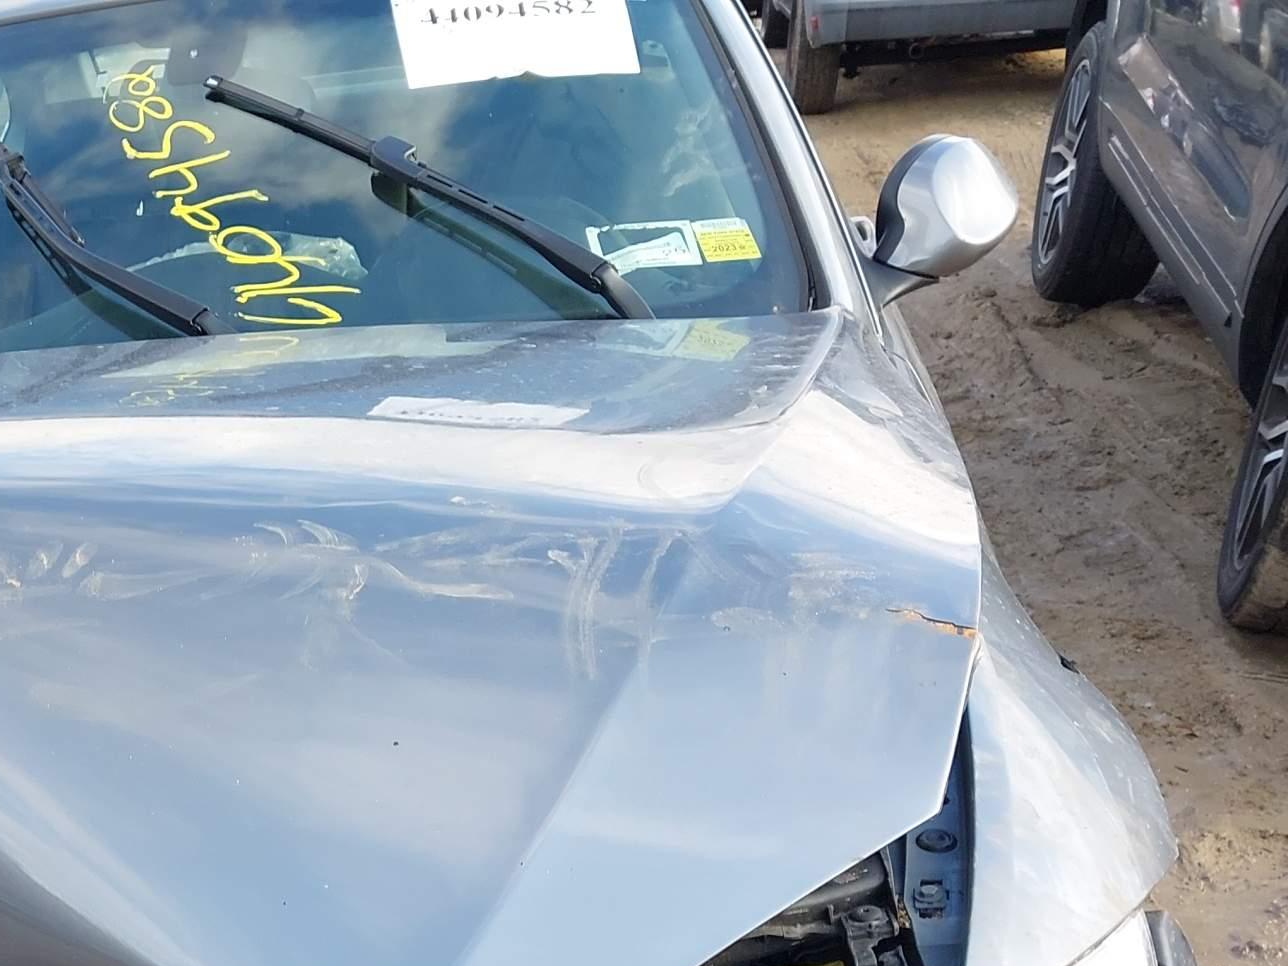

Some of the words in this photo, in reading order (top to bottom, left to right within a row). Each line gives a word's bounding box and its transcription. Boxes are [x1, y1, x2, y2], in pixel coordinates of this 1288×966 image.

[420, 0, 596, 25] 44094582
[103, 65, 362, 325] 44094582
[711, 243, 738, 253] 2023
